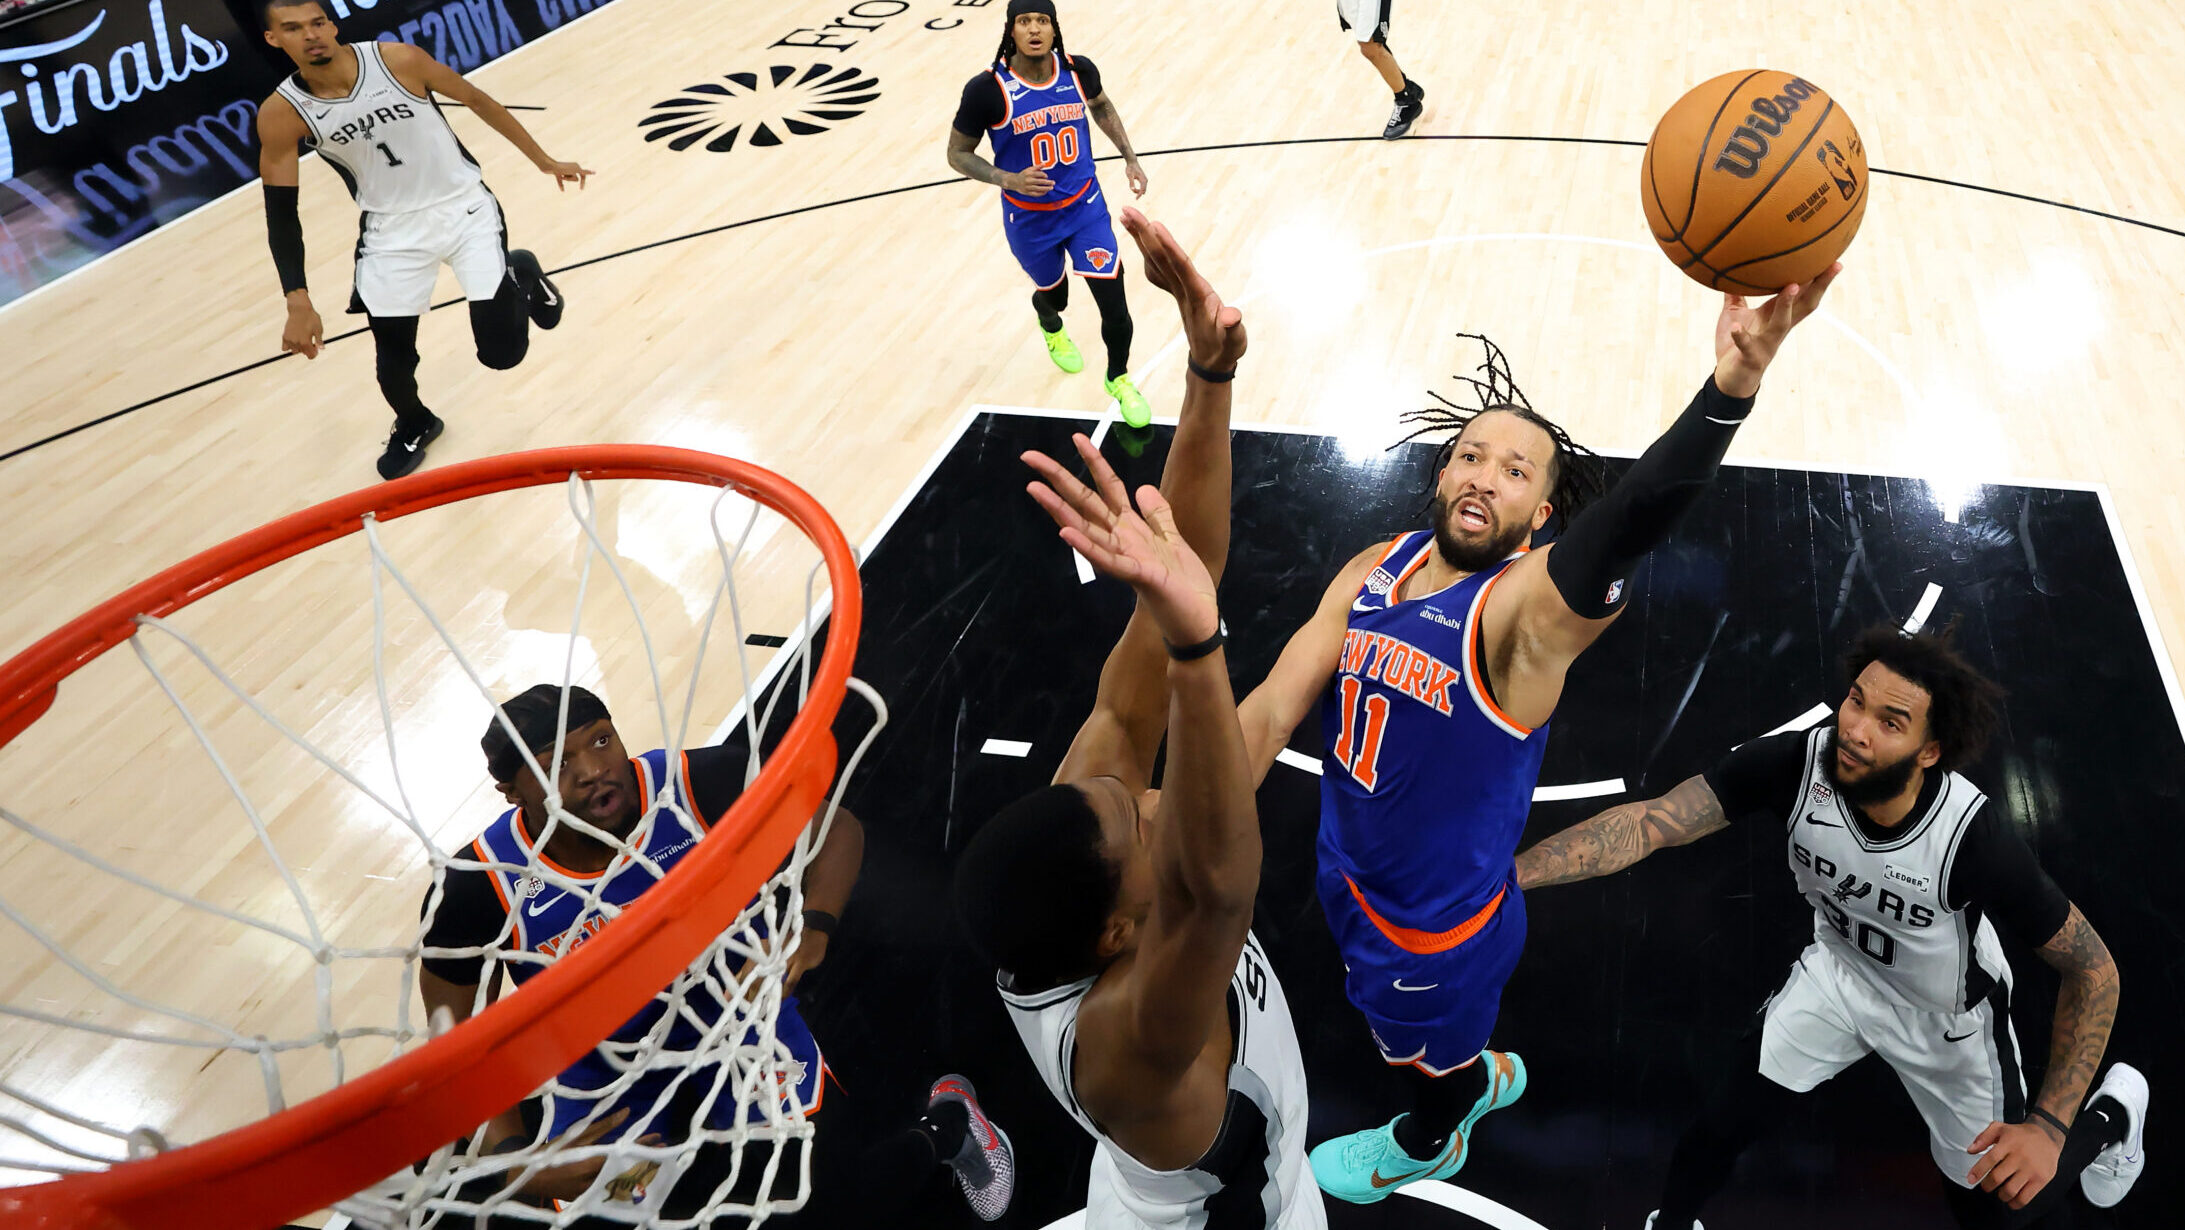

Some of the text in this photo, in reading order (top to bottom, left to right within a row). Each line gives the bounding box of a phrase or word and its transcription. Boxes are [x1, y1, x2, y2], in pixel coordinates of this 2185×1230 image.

[329, 103, 415, 146] SPURS
[1713, 77, 1821, 179] Wilson
[376, 142, 403, 168] 1
[1030, 125, 1079, 171] 00
[1434, 612, 1462, 630] dhabi
[1334, 674, 1390, 794] 11
[1793, 843, 1935, 928] SPURS
[1889, 869, 1924, 888] LEDGER
[1821, 893, 1897, 969] 30
